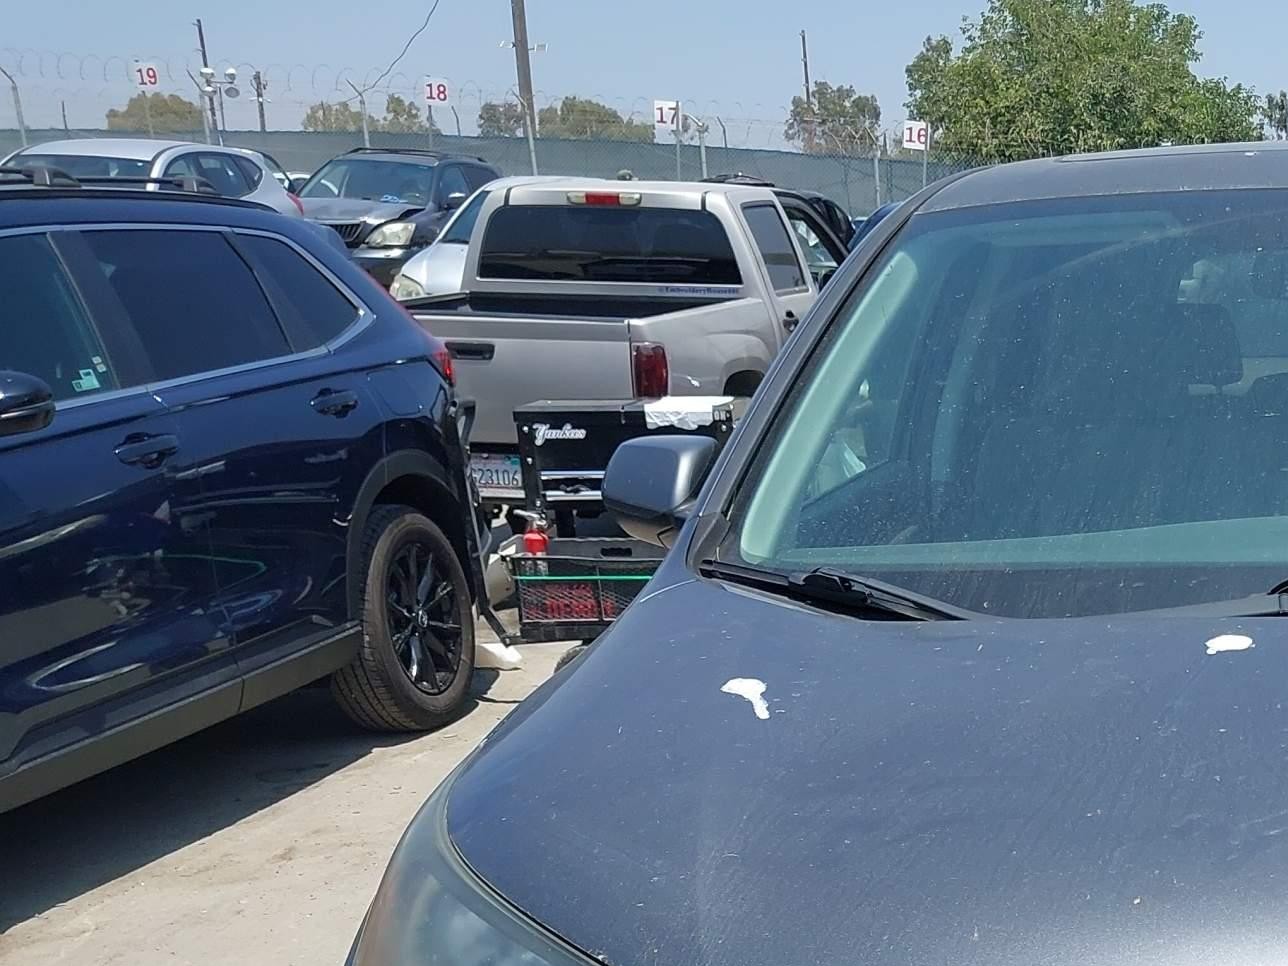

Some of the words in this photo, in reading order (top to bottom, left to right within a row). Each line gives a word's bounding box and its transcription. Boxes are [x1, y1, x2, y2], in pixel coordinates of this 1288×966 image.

[135, 67, 158, 86] 19
[425, 82, 447, 102] 18
[655, 106, 677, 125] 17
[905, 126, 927, 145] 16
[532, 422, 587, 446] Yankees
